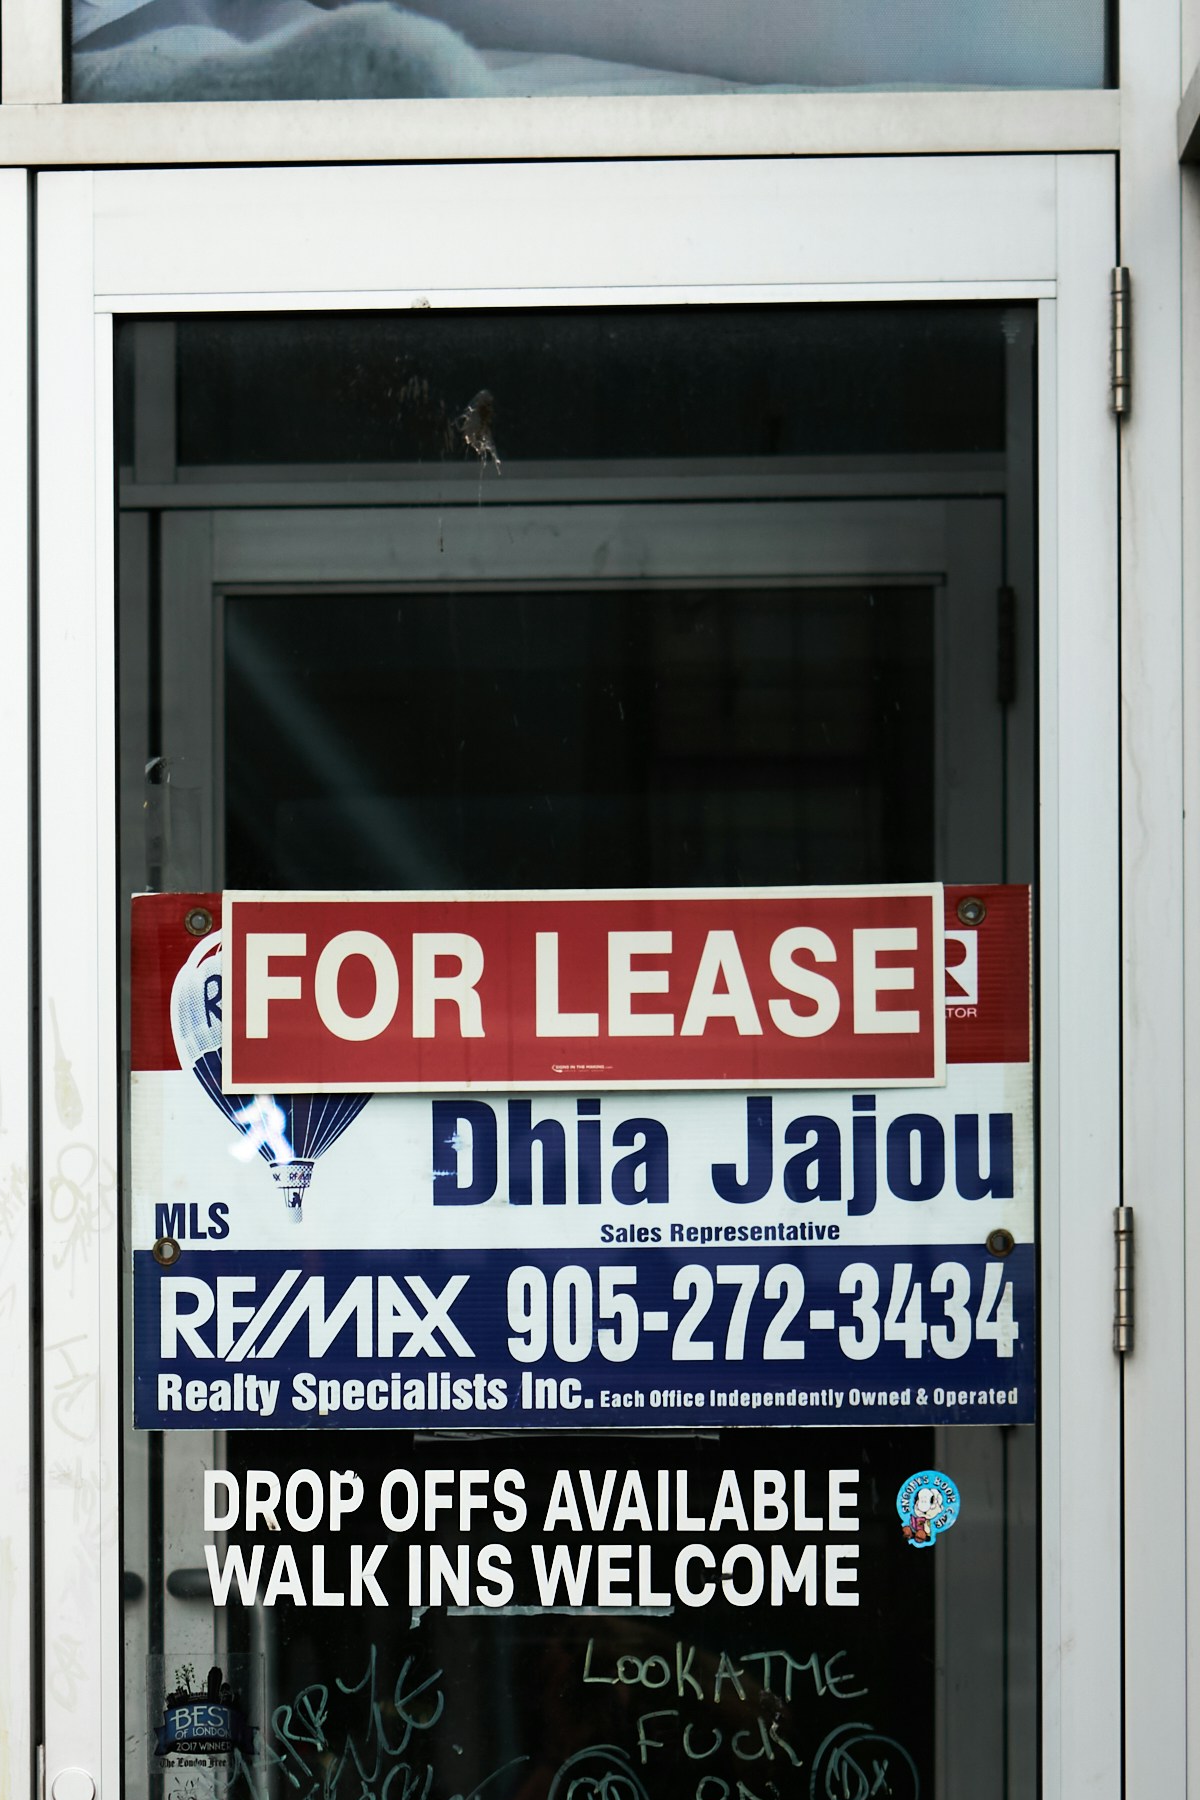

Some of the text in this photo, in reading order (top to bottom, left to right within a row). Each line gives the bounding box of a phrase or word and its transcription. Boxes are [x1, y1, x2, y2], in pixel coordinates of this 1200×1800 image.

[245, 930, 486, 1042] FOR
[535, 926, 920, 1038] LEASE
[432, 1094, 1014, 1217] Dhia Jajou
[155, 1202, 230, 1240] MLS
[600, 1221, 841, 1245] Sales Representative
[160, 1261, 1020, 1364] RE/MAX 905-272-3434
[157, 1371, 594, 1417] Realty Specialists Inc.
[600, 1386, 1019, 1412] Each Office Independently Owned & Operated
[202, 1468, 860, 1533] DROP OFFS AVAILABLE
[203, 1543, 860, 1607] WALK INS WELCOME
[170, 1705, 231, 1731] BEST
[175, 1726, 232, 1740] OF LONDON
[160, 1757, 176, 1769] The
[176, 1757, 207, 1769] London
[176, 1741, 232, 1752] 2017 WINNER
